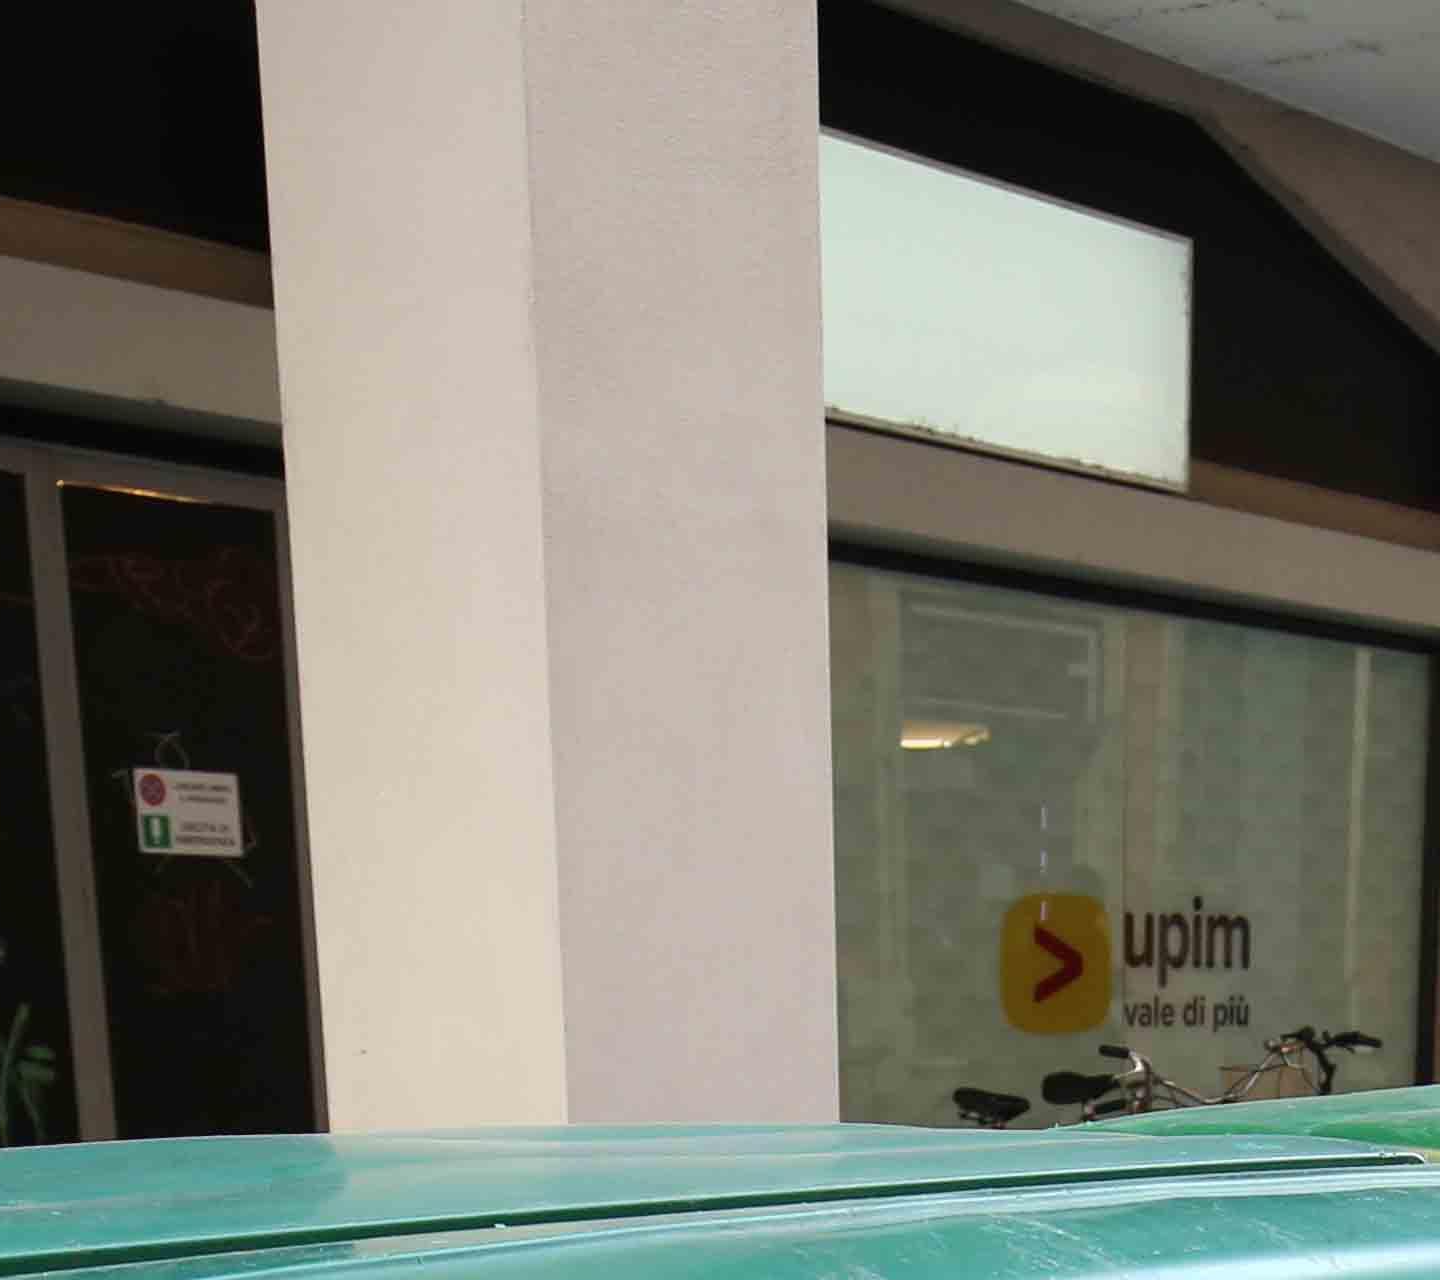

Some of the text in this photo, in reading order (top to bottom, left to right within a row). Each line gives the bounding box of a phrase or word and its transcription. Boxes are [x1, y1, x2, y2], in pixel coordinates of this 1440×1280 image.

[1123, 896, 1250, 987] upim
[1123, 996, 1250, 1033] vale di più
